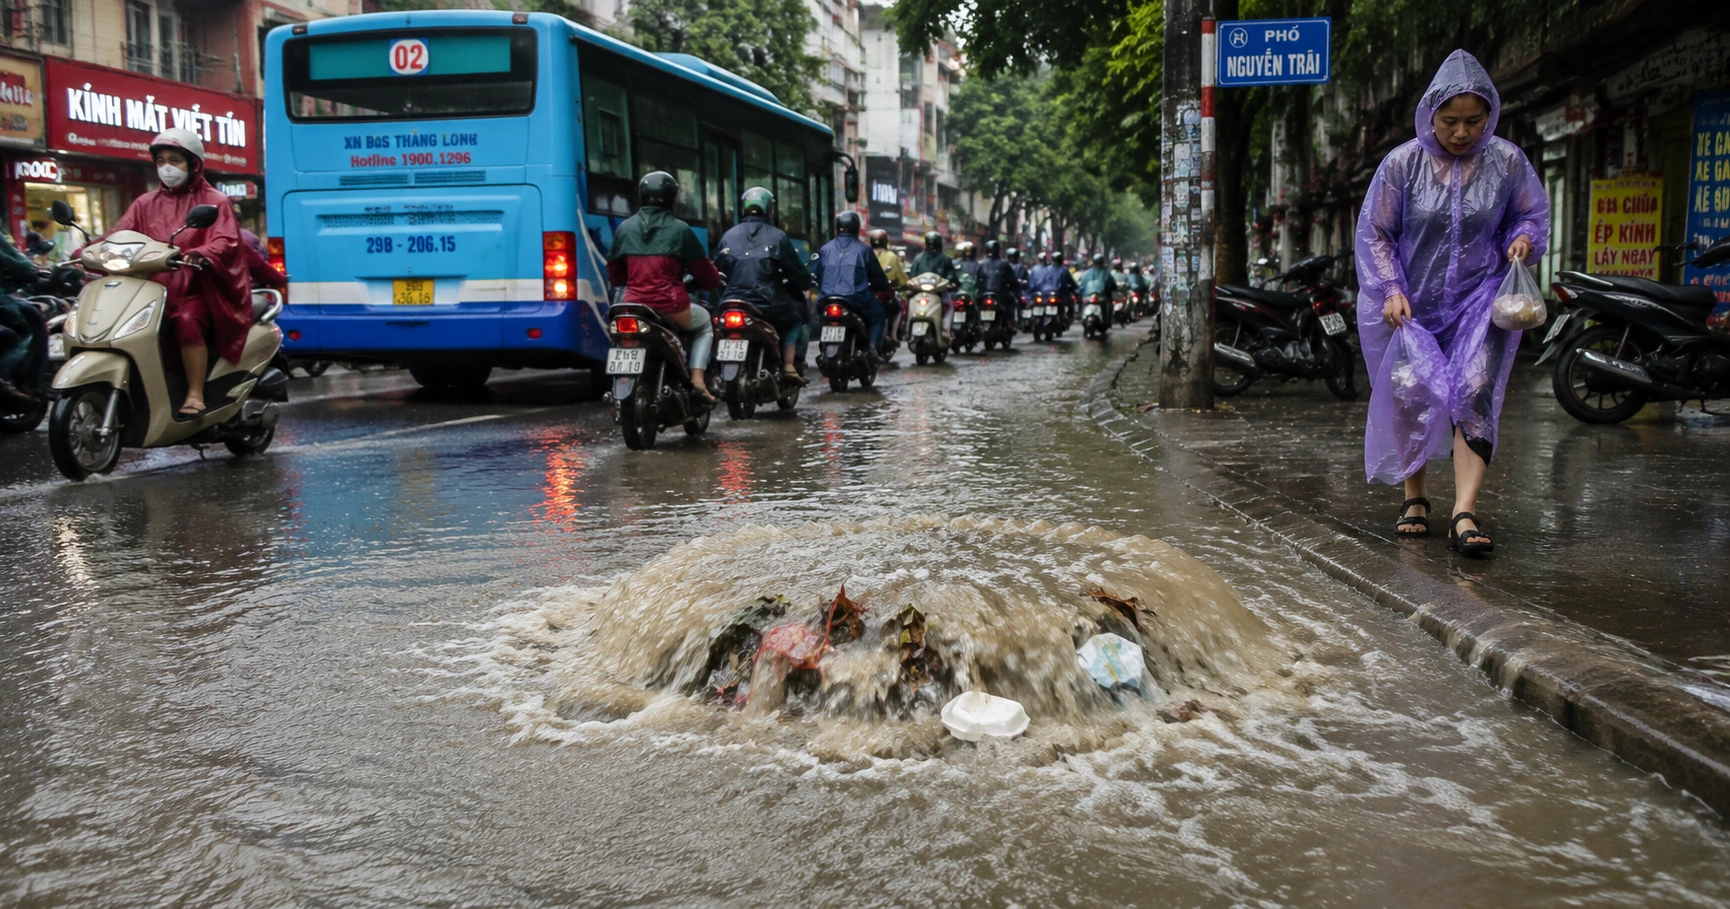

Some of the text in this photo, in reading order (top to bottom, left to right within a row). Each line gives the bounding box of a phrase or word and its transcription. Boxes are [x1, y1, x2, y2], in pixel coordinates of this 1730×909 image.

[1265, 25, 1300, 42] PHỐ
[394, 44, 423, 70] 02
[402, 152, 471, 166] 1900.1296
[366, 236, 393, 253] 29B
[407, 235, 456, 252] 206.15
